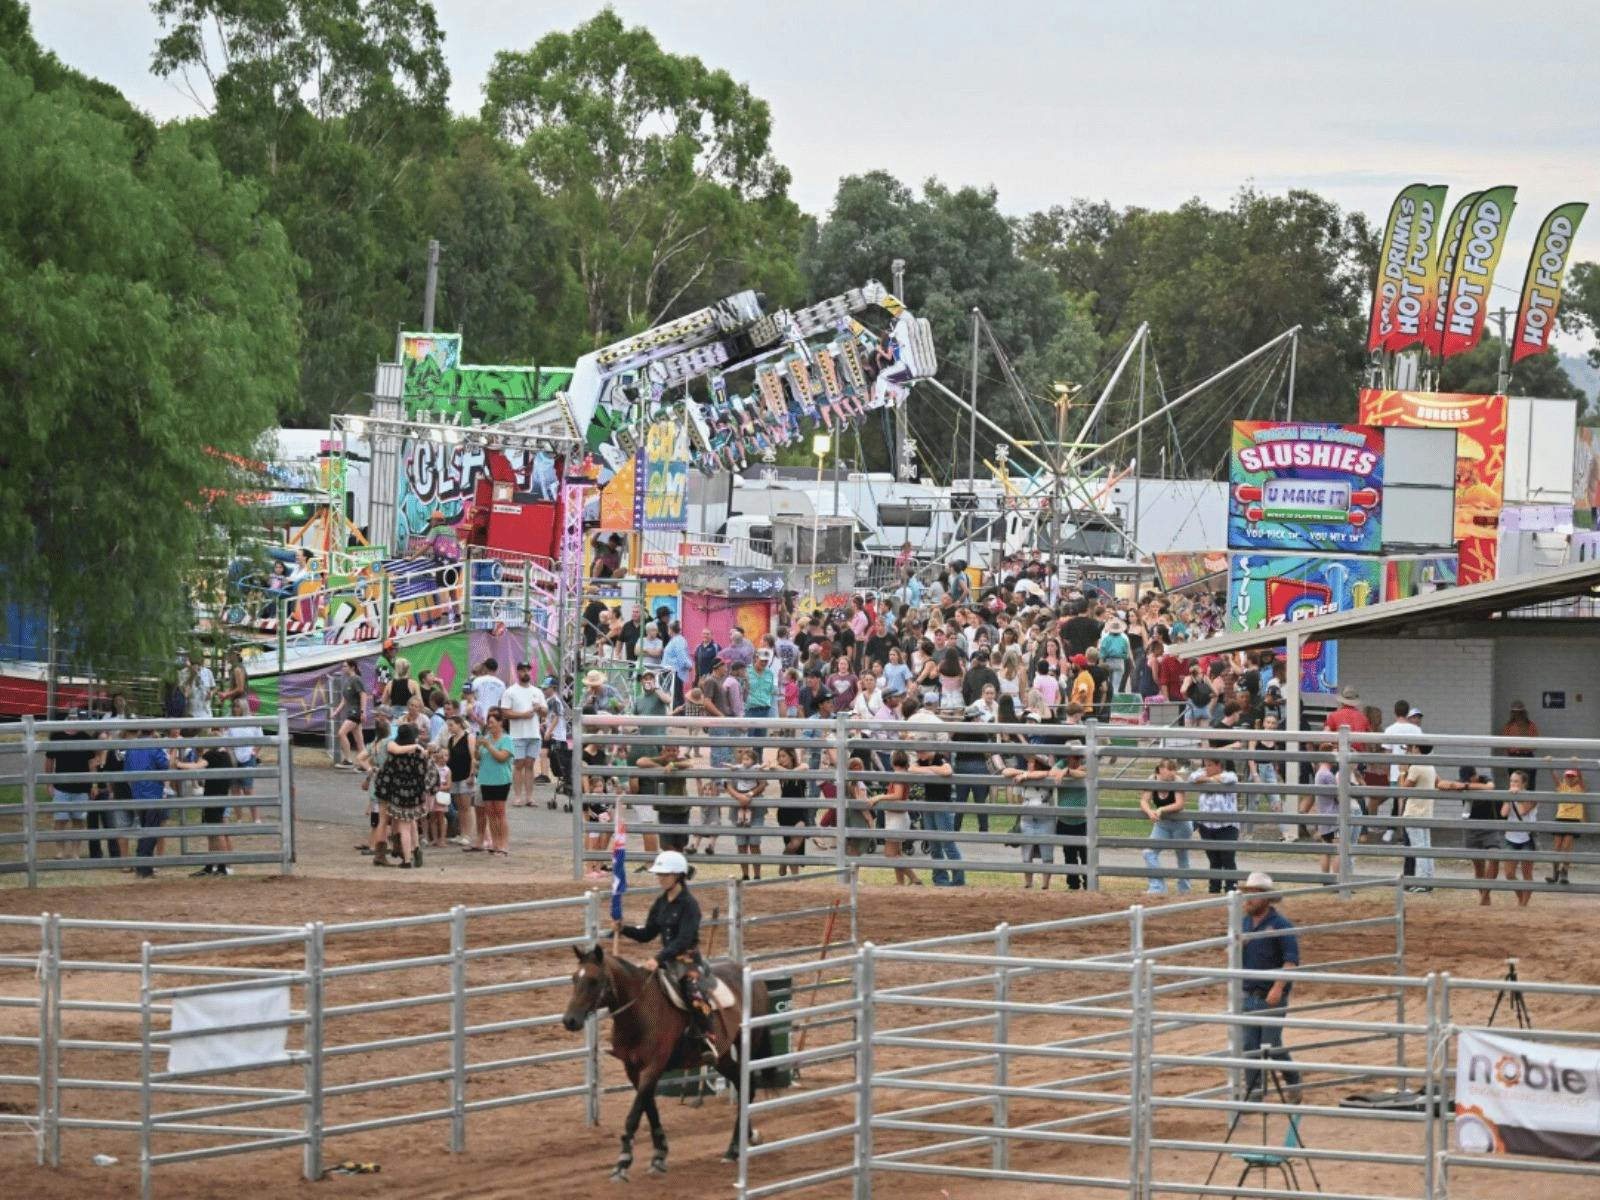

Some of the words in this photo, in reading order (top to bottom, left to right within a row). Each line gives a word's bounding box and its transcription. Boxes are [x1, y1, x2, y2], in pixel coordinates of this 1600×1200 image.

[1385, 197, 1415, 281] DRINKS
[1464, 200, 1501, 275] FOOD
[1535, 216, 1572, 288] FOOD
[1397, 276, 1424, 334] HOT
[1450, 277, 1484, 335] HOT
[1523, 288, 1553, 346] HOT
[1417, 407, 1469, 421] BURGERS
[1239, 441, 1377, 476] SLUSHIES
[1268, 488, 1278, 501] U
[1282, 488, 1326, 504] MAKE
[1329, 490, 1346, 506] IT
[1293, 602, 1338, 621] Price
[1469, 1054, 1587, 1095] noble
